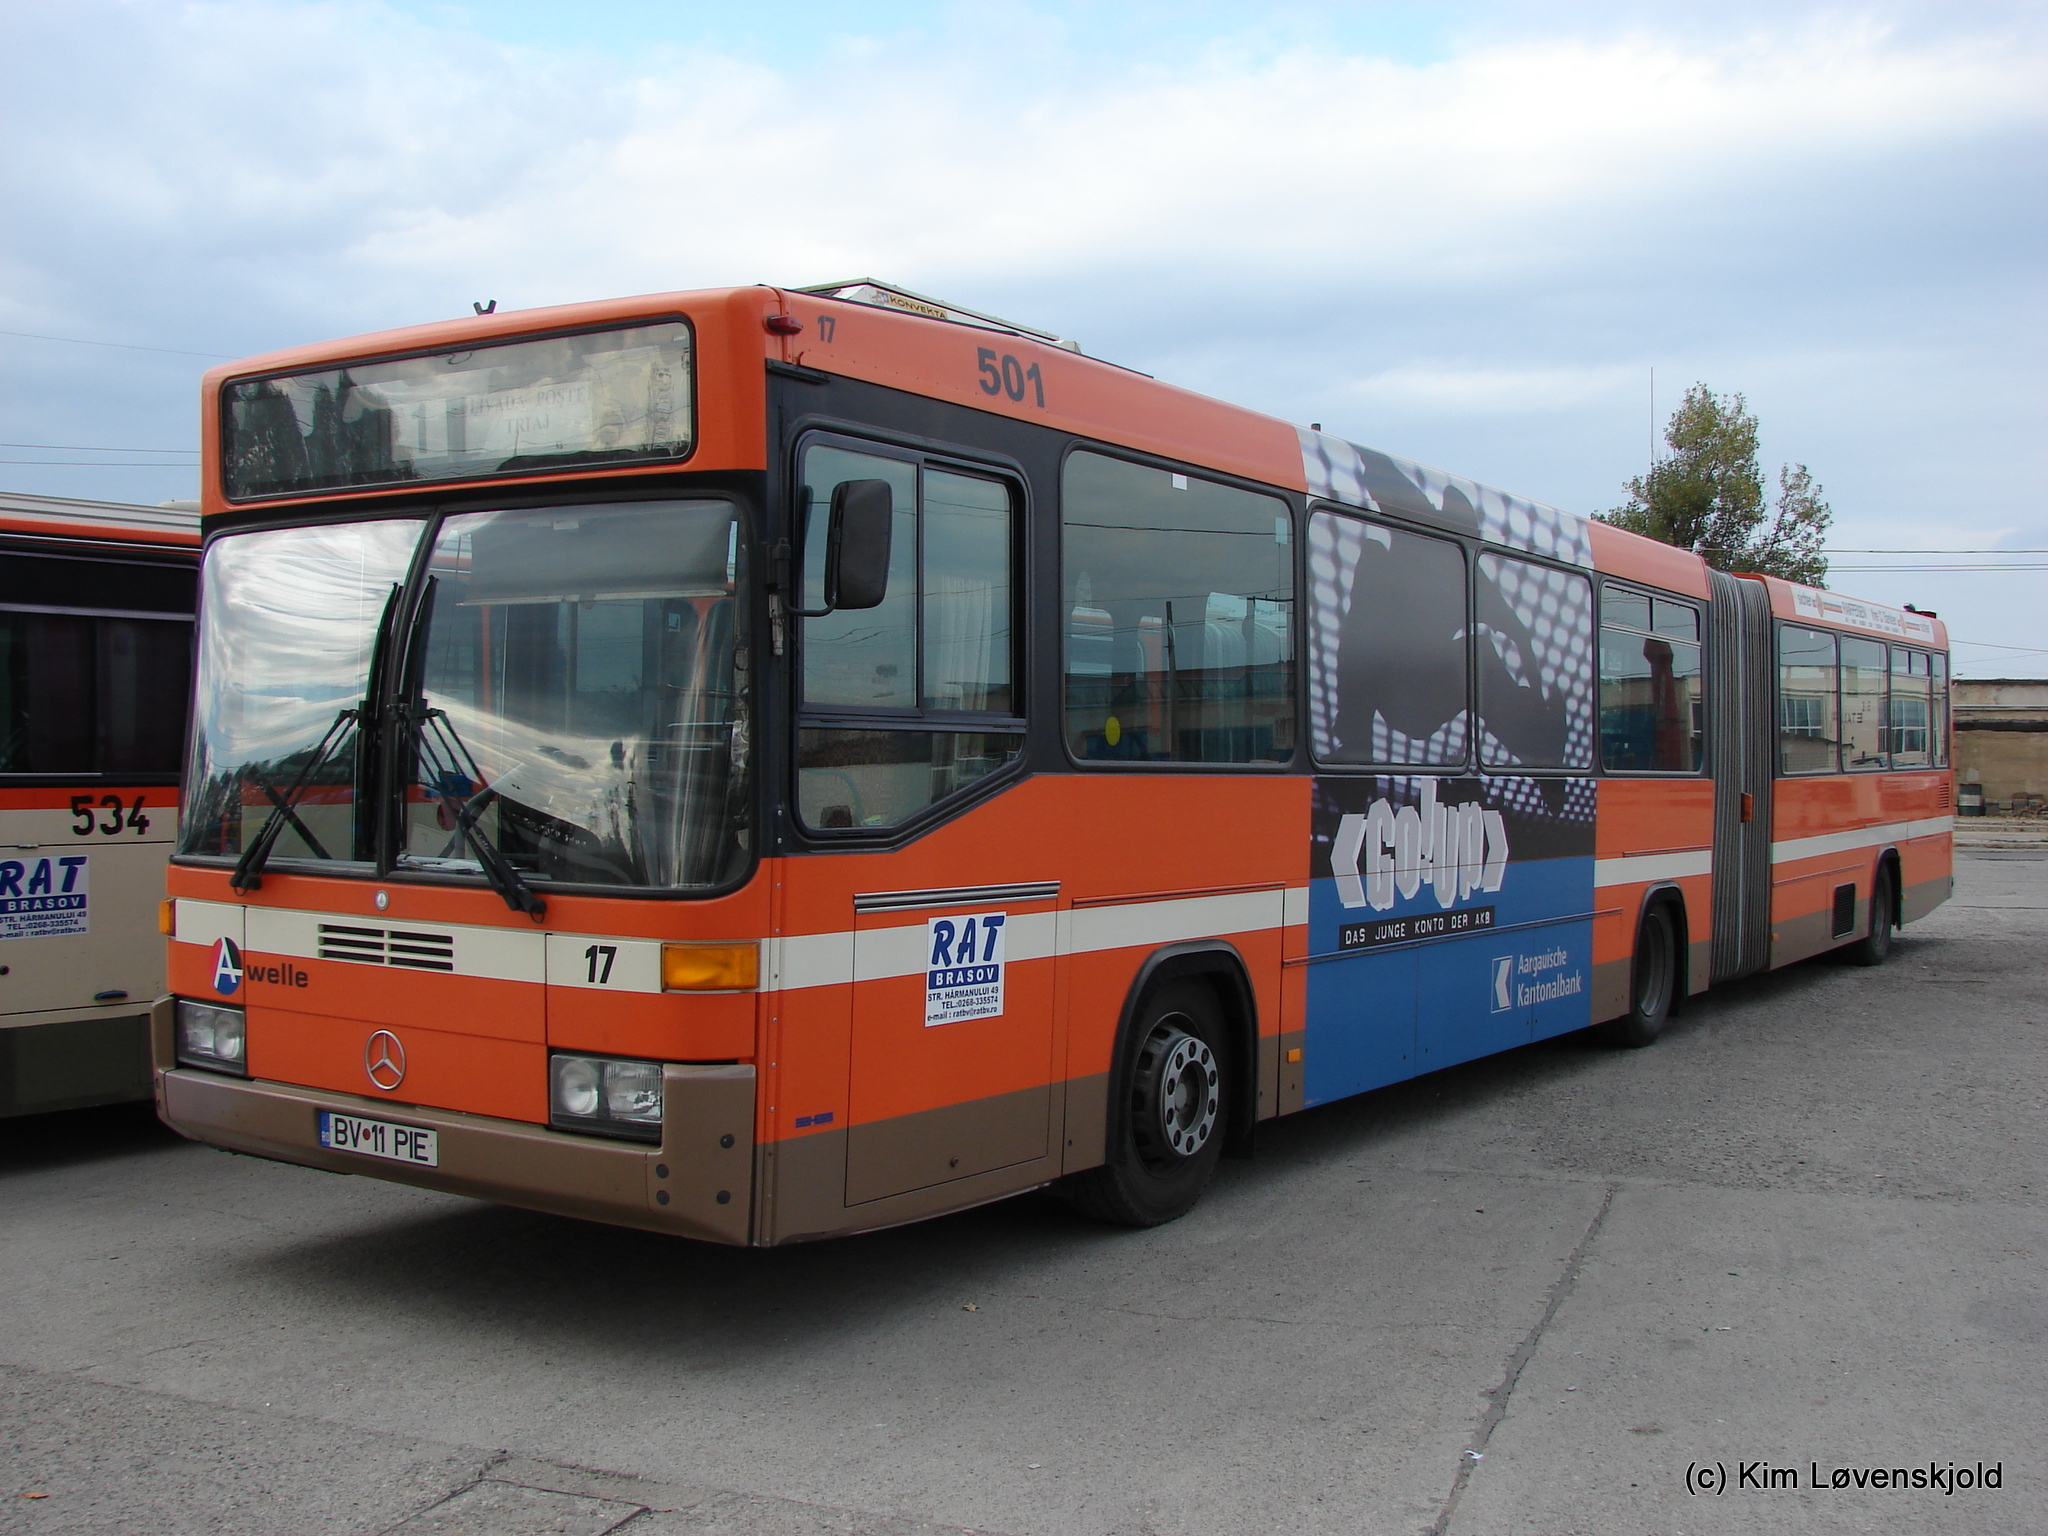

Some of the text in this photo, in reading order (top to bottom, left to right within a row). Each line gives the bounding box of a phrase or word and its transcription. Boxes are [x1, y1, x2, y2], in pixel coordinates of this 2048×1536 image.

[889, 296, 946, 319] KONVEKTA
[817, 315, 836, 343] 17
[977, 346, 1045, 408] 501
[70, 795, 150, 836] 534
[0, 856, 88, 898] RAT
[7, 896, 80, 912] BRASOV
[77, 910, 87, 918] 49
[931, 915, 1005, 968] RAT
[1345, 911, 1491, 945] DAS JUNGE KONTO DER AKB
[247, 962, 309, 988] welle
[585, 944, 618, 984] 17
[935, 967, 995, 986] BRASOV
[1518, 945, 1567, 977] Aargauische
[927, 992, 944, 1002] STR.
[990, 986, 999, 995] 49
[1517, 969, 1582, 1008] Kantonalbank
[927, 1010, 948, 1022] e-mail
[334, 1117, 362, 1148] BV
[371, 1124, 386, 1153] 11
[394, 1128, 430, 1162] PIE
